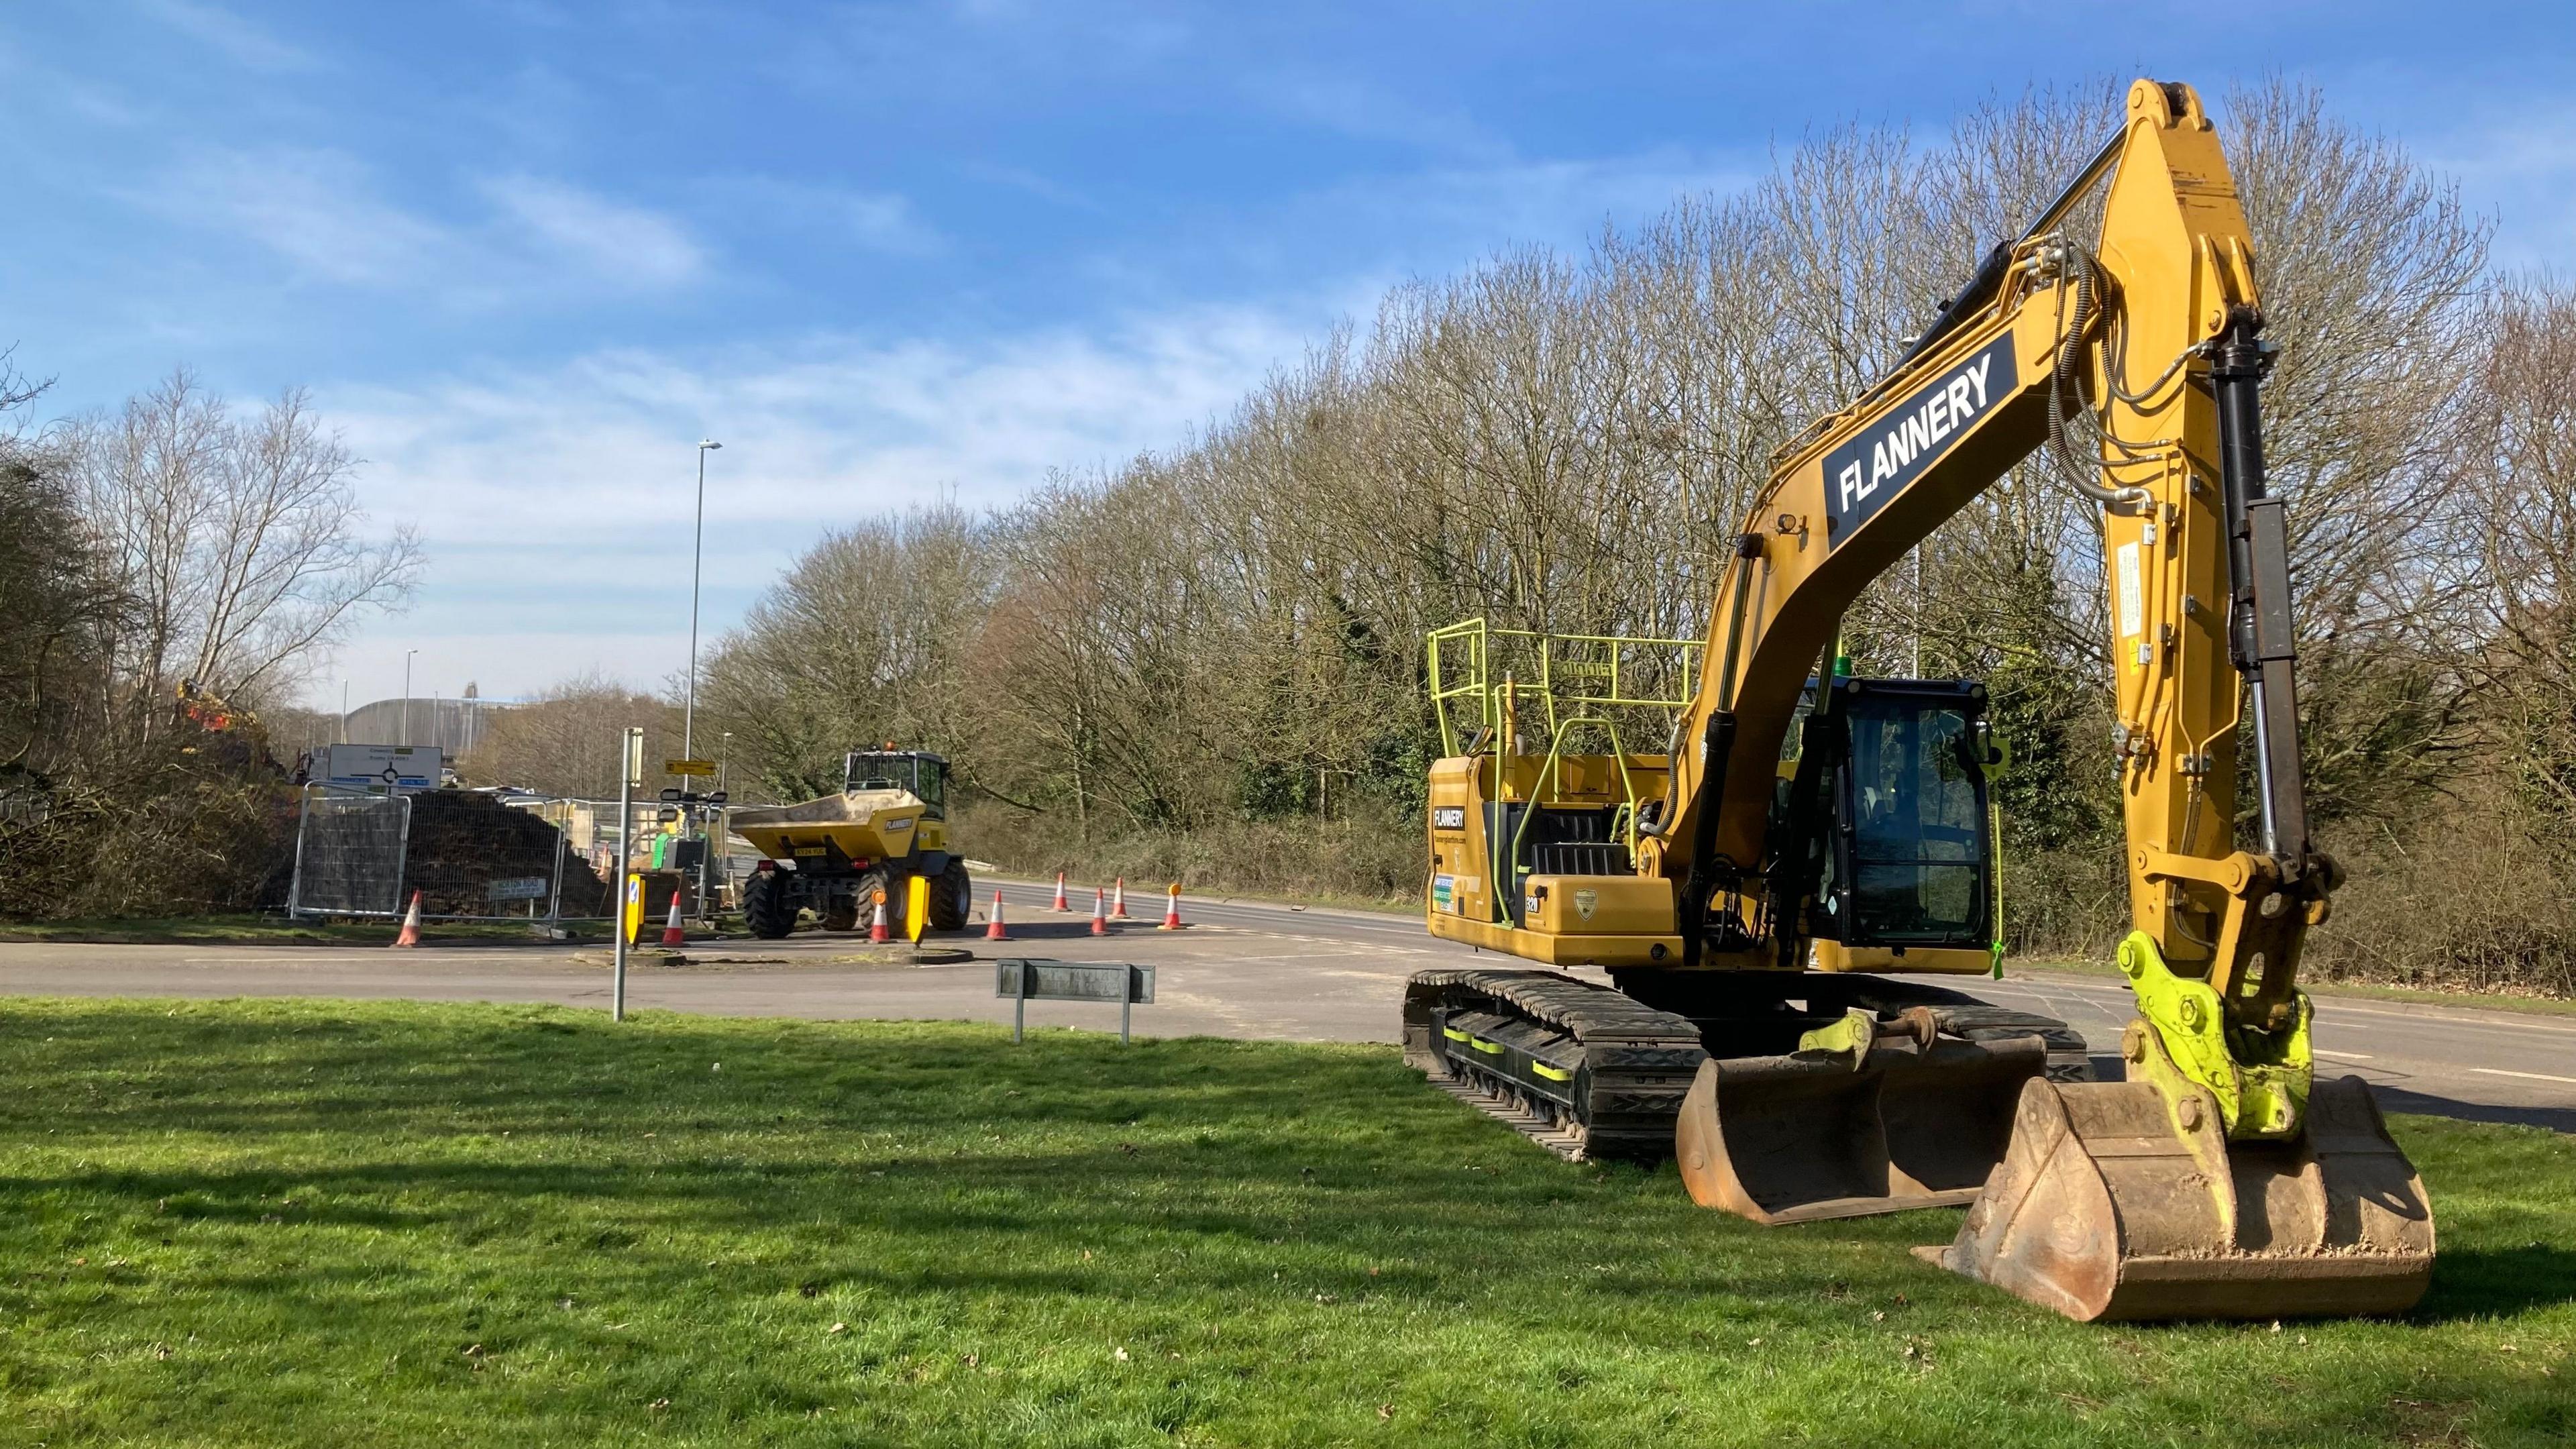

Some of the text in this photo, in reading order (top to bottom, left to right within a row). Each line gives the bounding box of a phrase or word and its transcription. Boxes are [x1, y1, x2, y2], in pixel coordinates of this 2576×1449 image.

[1839, 352, 1991, 513] FLANNERY
[885, 819, 912, 829] FLANNERY
[1434, 810, 1464, 827] FLANNERY
[1527, 896, 1539, 912] 320
